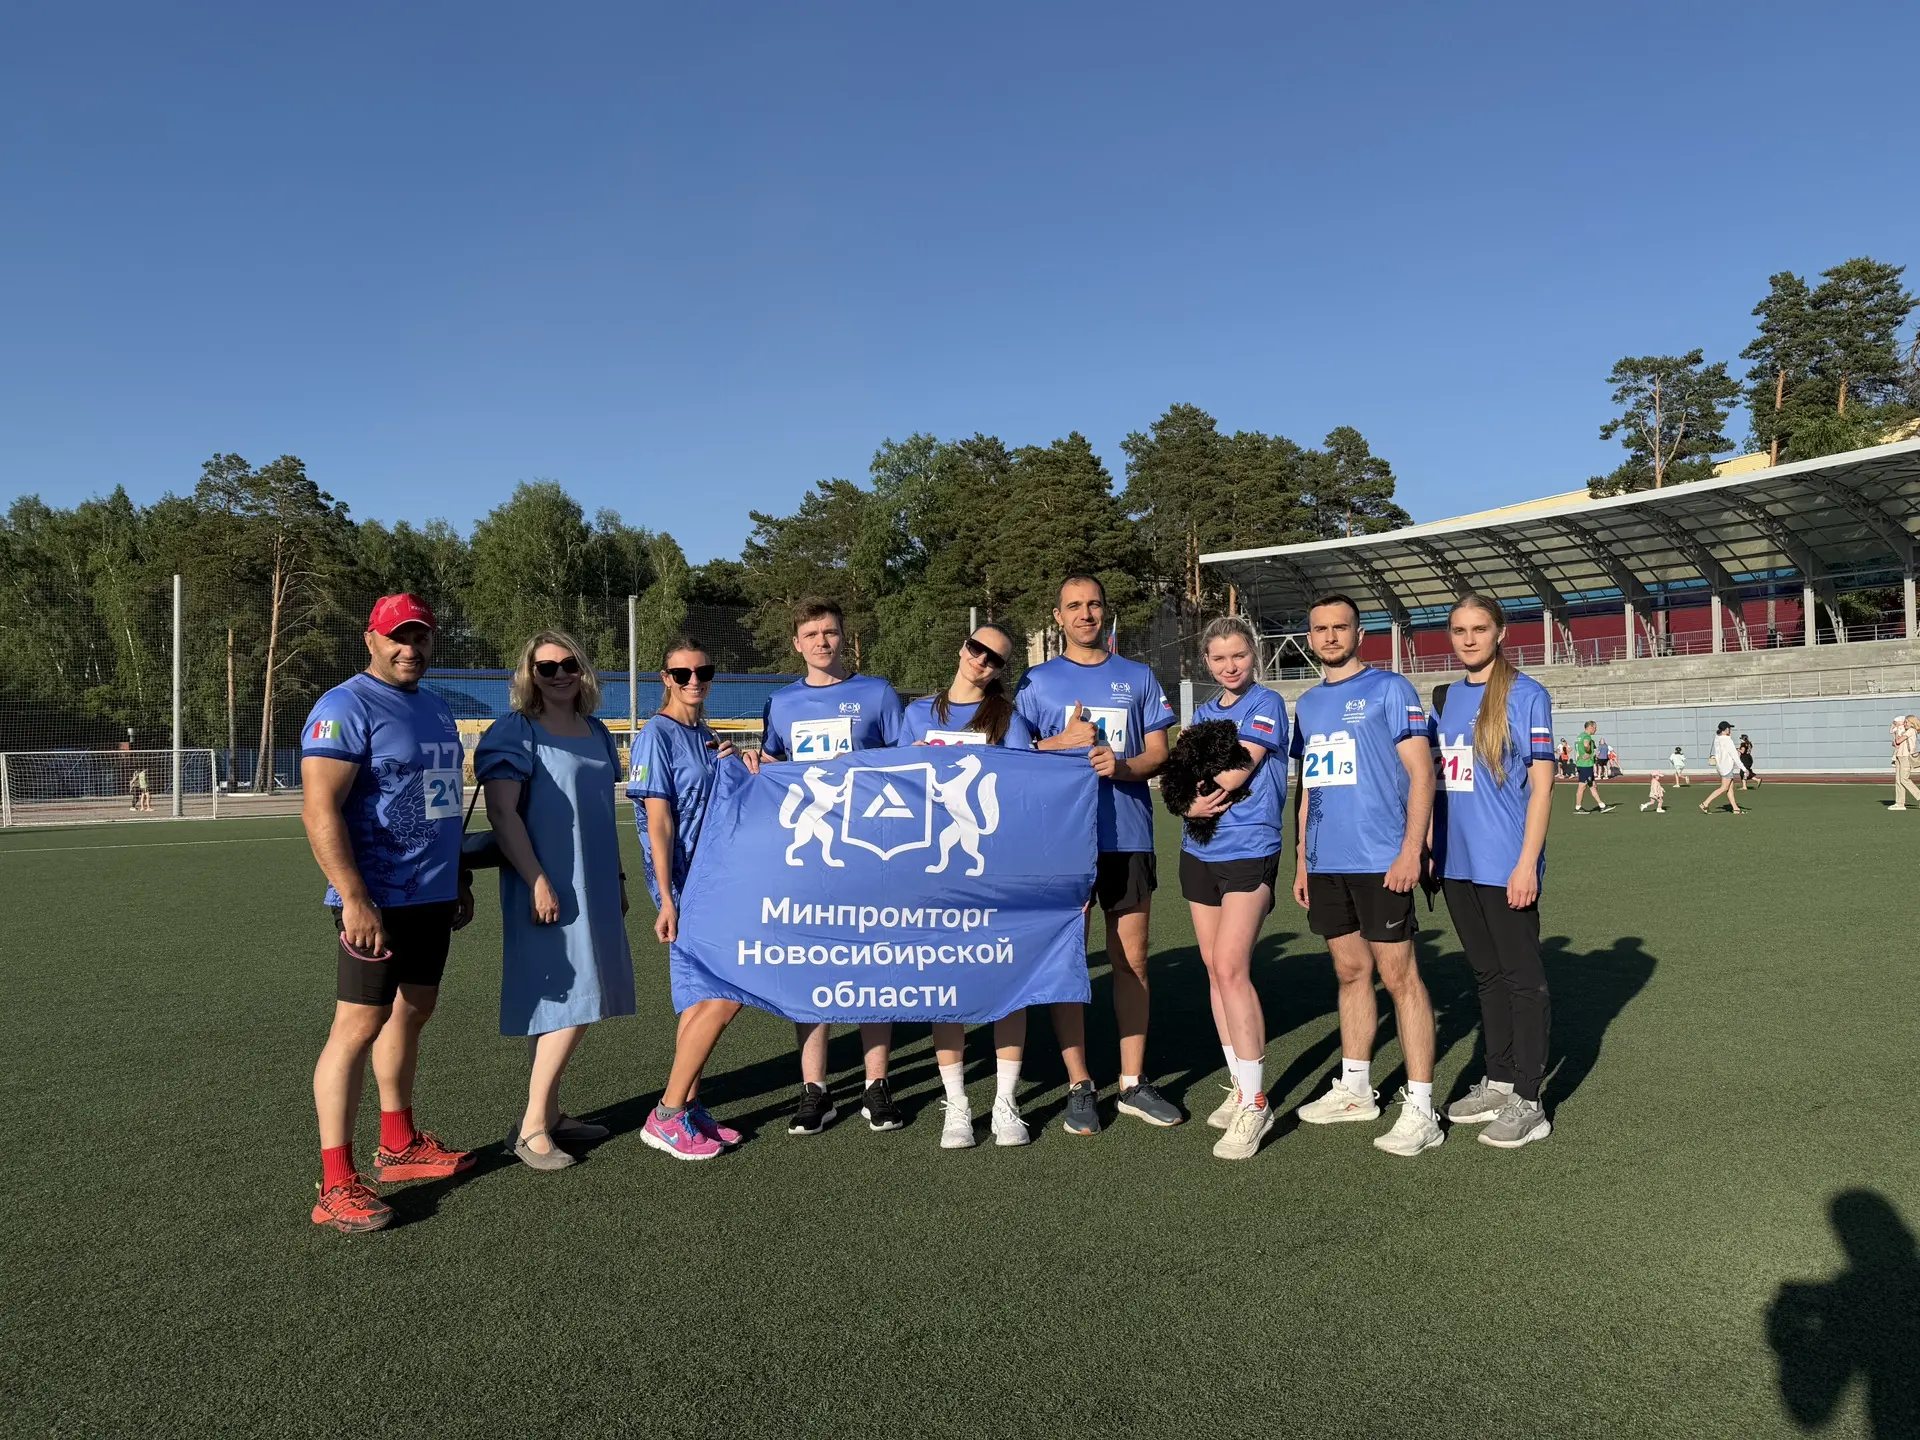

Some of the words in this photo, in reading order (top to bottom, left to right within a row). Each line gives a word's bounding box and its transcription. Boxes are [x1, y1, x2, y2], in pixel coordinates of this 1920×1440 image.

[1080, 716, 1123, 742] 1/1
[1305, 750, 1354, 777] 21/3
[429, 779, 460, 807] 21
[761, 897, 998, 933] Минпромторг
[737, 937, 1014, 971] Новосибирской
[812, 980, 957, 1008] области
